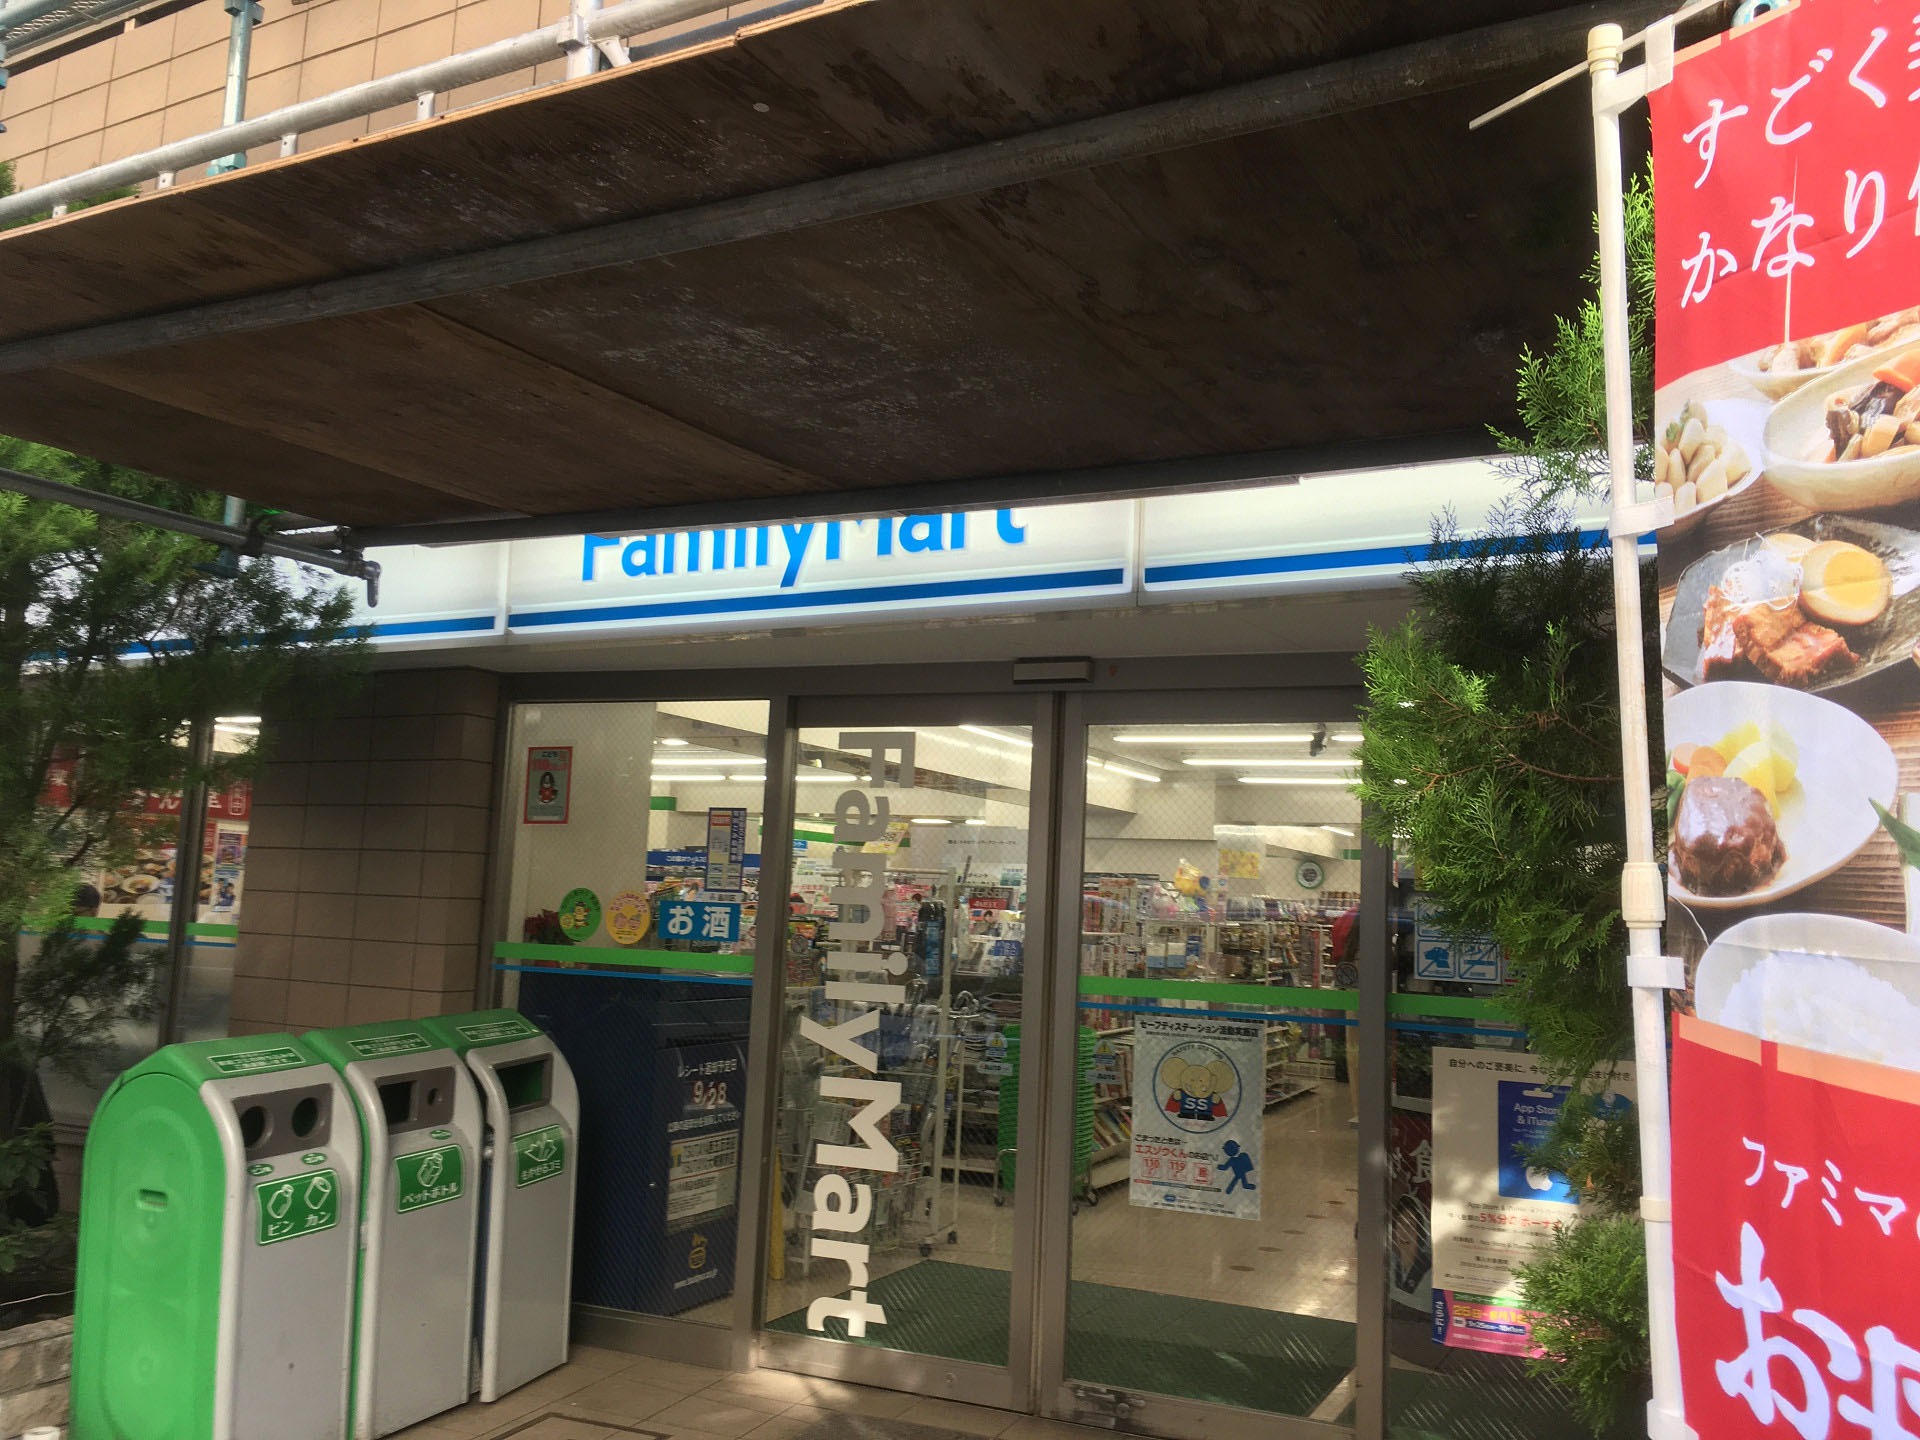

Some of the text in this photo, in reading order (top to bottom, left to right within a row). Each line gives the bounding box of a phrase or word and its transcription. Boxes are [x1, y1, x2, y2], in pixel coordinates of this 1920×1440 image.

[1682, 15, 1920, 189] すごく
[1681, 161, 1920, 308] かなり
[667, 905, 732, 939] お酒
[800, 731, 917, 1339] FamilyMart
[1185, 1097, 1208, 1110] SS
[1514, 1102, 1535, 1114] App
[1517, 1115, 1526, 1124] &
[402, 1185, 459, 1203] ペットボトル
[1743, 1136, 1920, 1241] ファミマ
[267, 1212, 331, 1236] ビン カン
